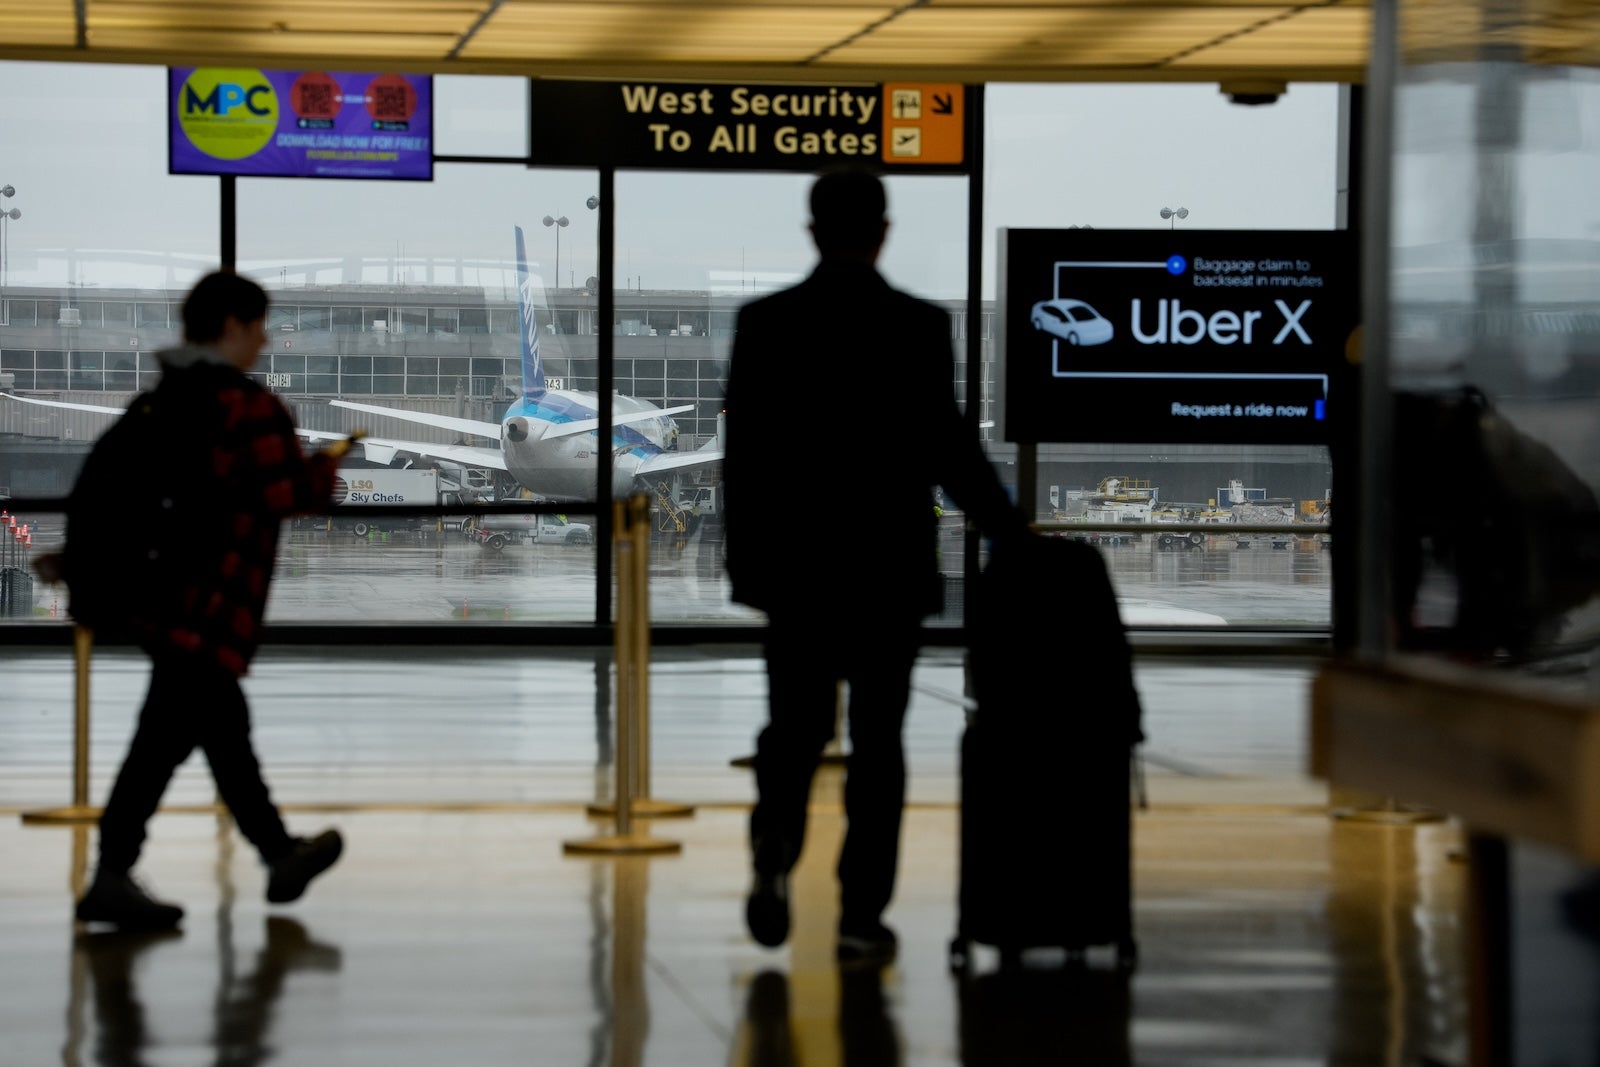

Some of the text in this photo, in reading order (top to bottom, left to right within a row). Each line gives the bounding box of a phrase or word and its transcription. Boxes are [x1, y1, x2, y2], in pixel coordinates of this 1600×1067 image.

[186, 82, 271, 116] MPC
[621, 85, 877, 123] West Security
[648, 124, 877, 155] To All Gates
[1193, 257, 1311, 273] Baggage claim to
[1193, 273, 1324, 287] backseat in minutes
[1131, 298, 1313, 345] Uber X
[1171, 402, 1309, 419] Request a ride now
[351, 479, 374, 489] LSG
[351, 492, 405, 503] Sky Chefs
